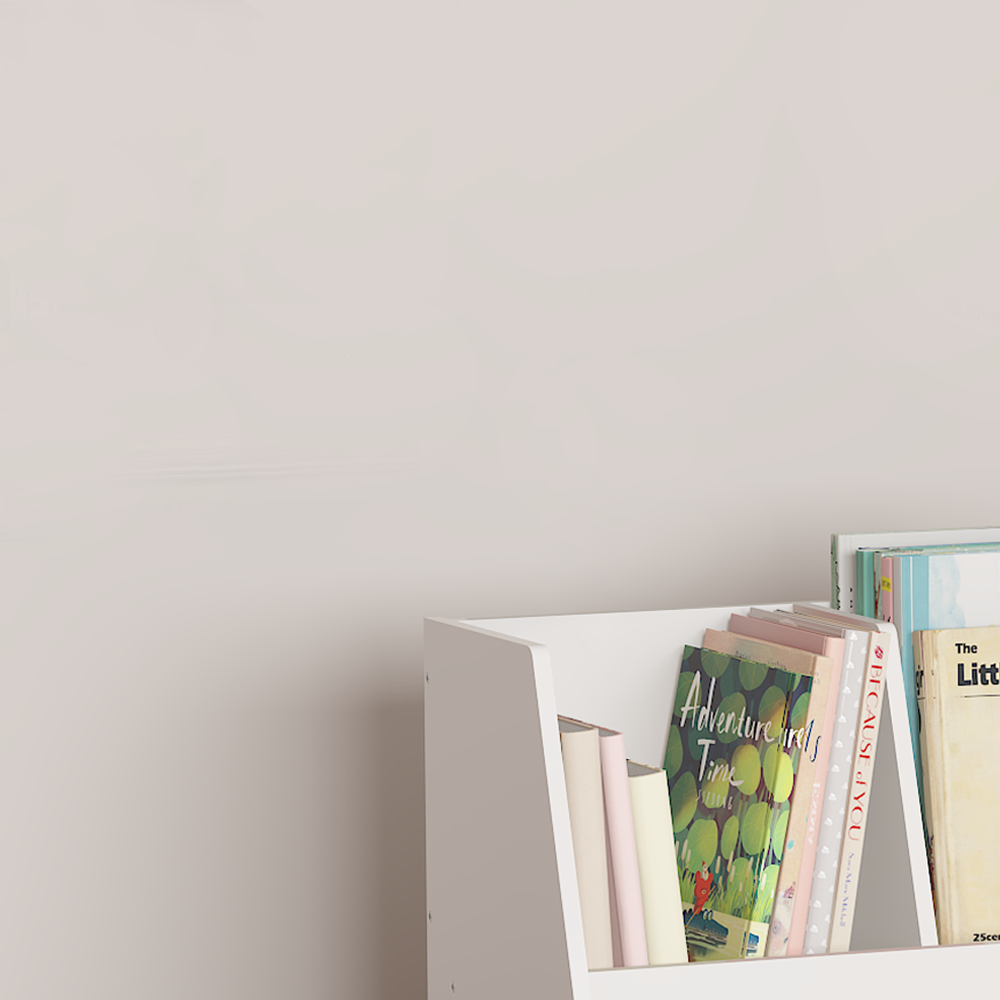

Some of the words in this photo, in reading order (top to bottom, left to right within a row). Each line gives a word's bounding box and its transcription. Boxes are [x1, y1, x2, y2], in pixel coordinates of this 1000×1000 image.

[955, 643, 978, 654] The
[680, 670, 775, 743] Adventure
[857, 664, 883, 766] BECAUSE
[697, 738, 744, 786] Time
[855, 771, 868, 785] of
[848, 791, 866, 842] YOU
